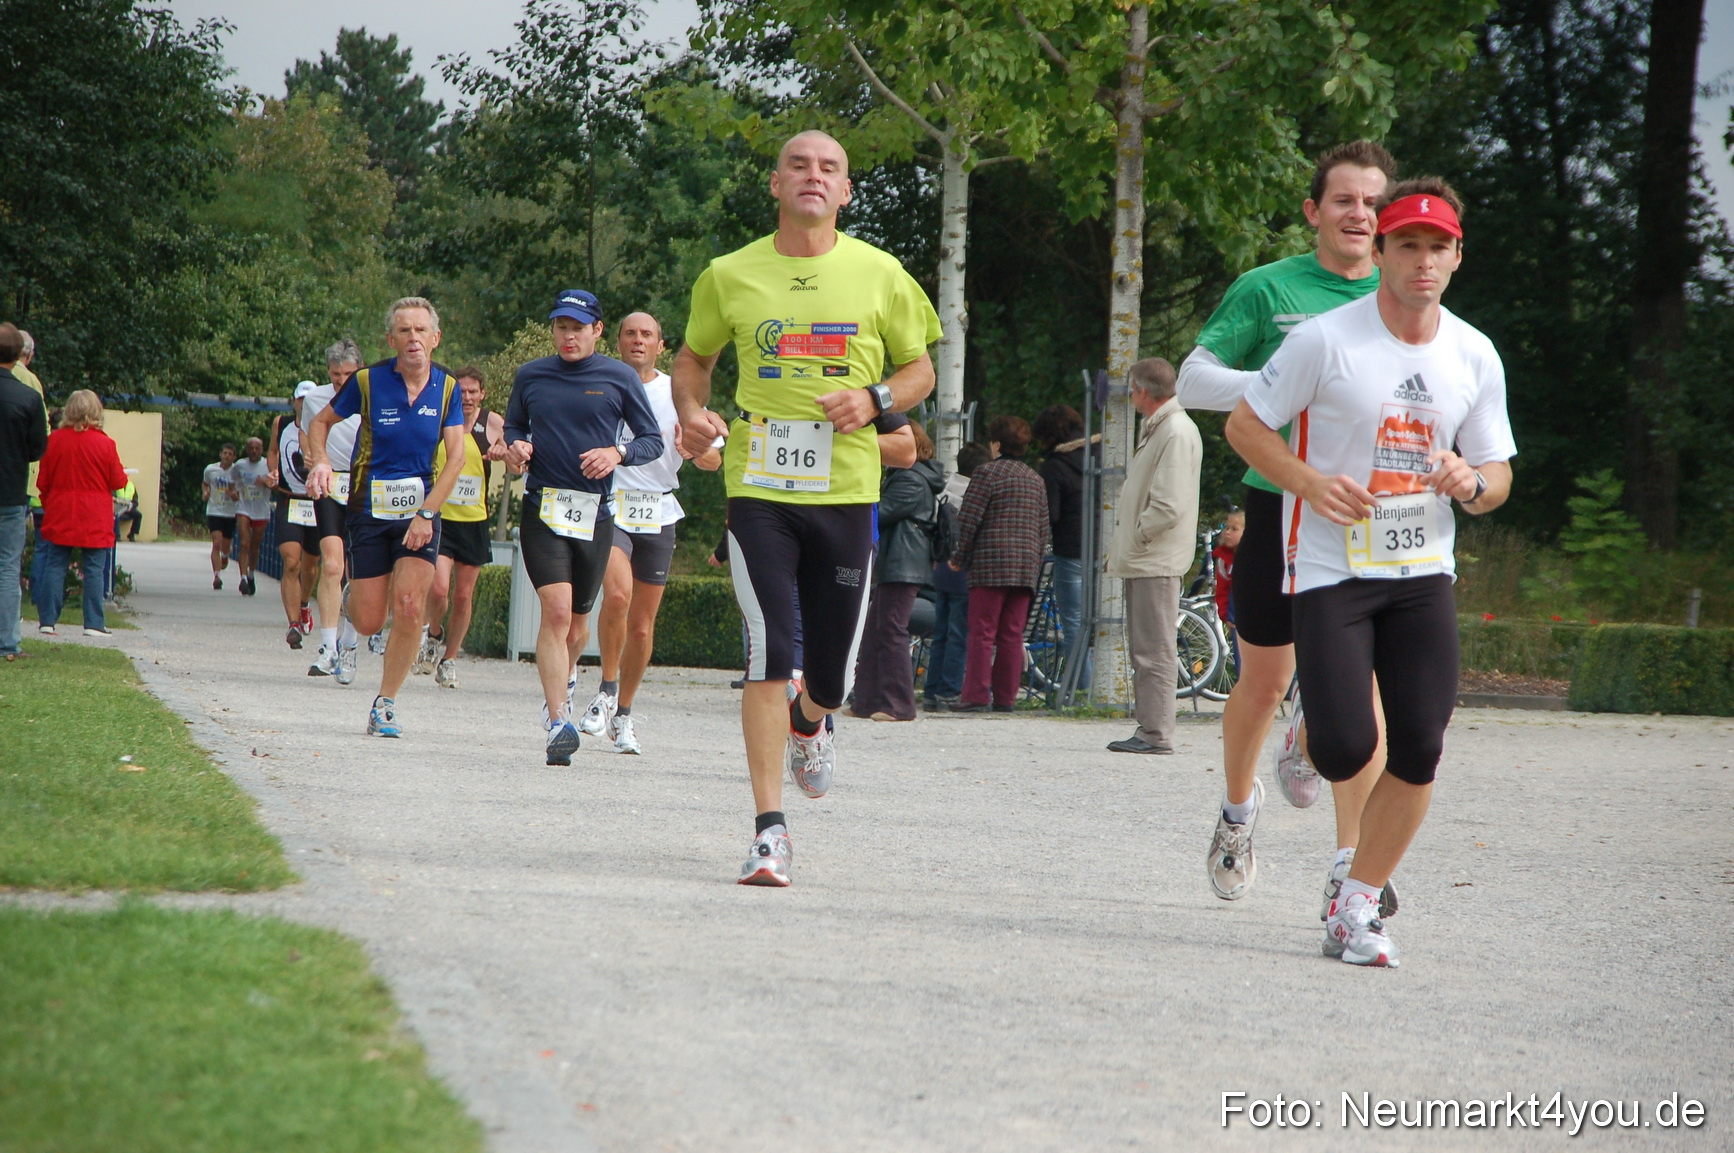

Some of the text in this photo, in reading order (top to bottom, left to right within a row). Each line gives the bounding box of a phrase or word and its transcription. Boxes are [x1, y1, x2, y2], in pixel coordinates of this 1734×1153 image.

[785, 346, 803, 354] BIEL
[1394, 390, 1433, 403] adidas
[770, 423, 791, 438] Rolf
[751, 441, 757, 451] B
[776, 447, 816, 468] 816
[385, 484, 417, 494] Wolfgang
[458, 487, 475, 496] 786
[391, 495, 416, 507] 660
[556, 493, 573, 503] Dirk
[625, 493, 660, 503] Hans Peter
[564, 509, 582, 522] 43
[629, 507, 653, 519] 212
[1374, 504, 1425, 521] Benjamin
[1351, 530, 1358, 541] A
[1386, 527, 1425, 550] 335
